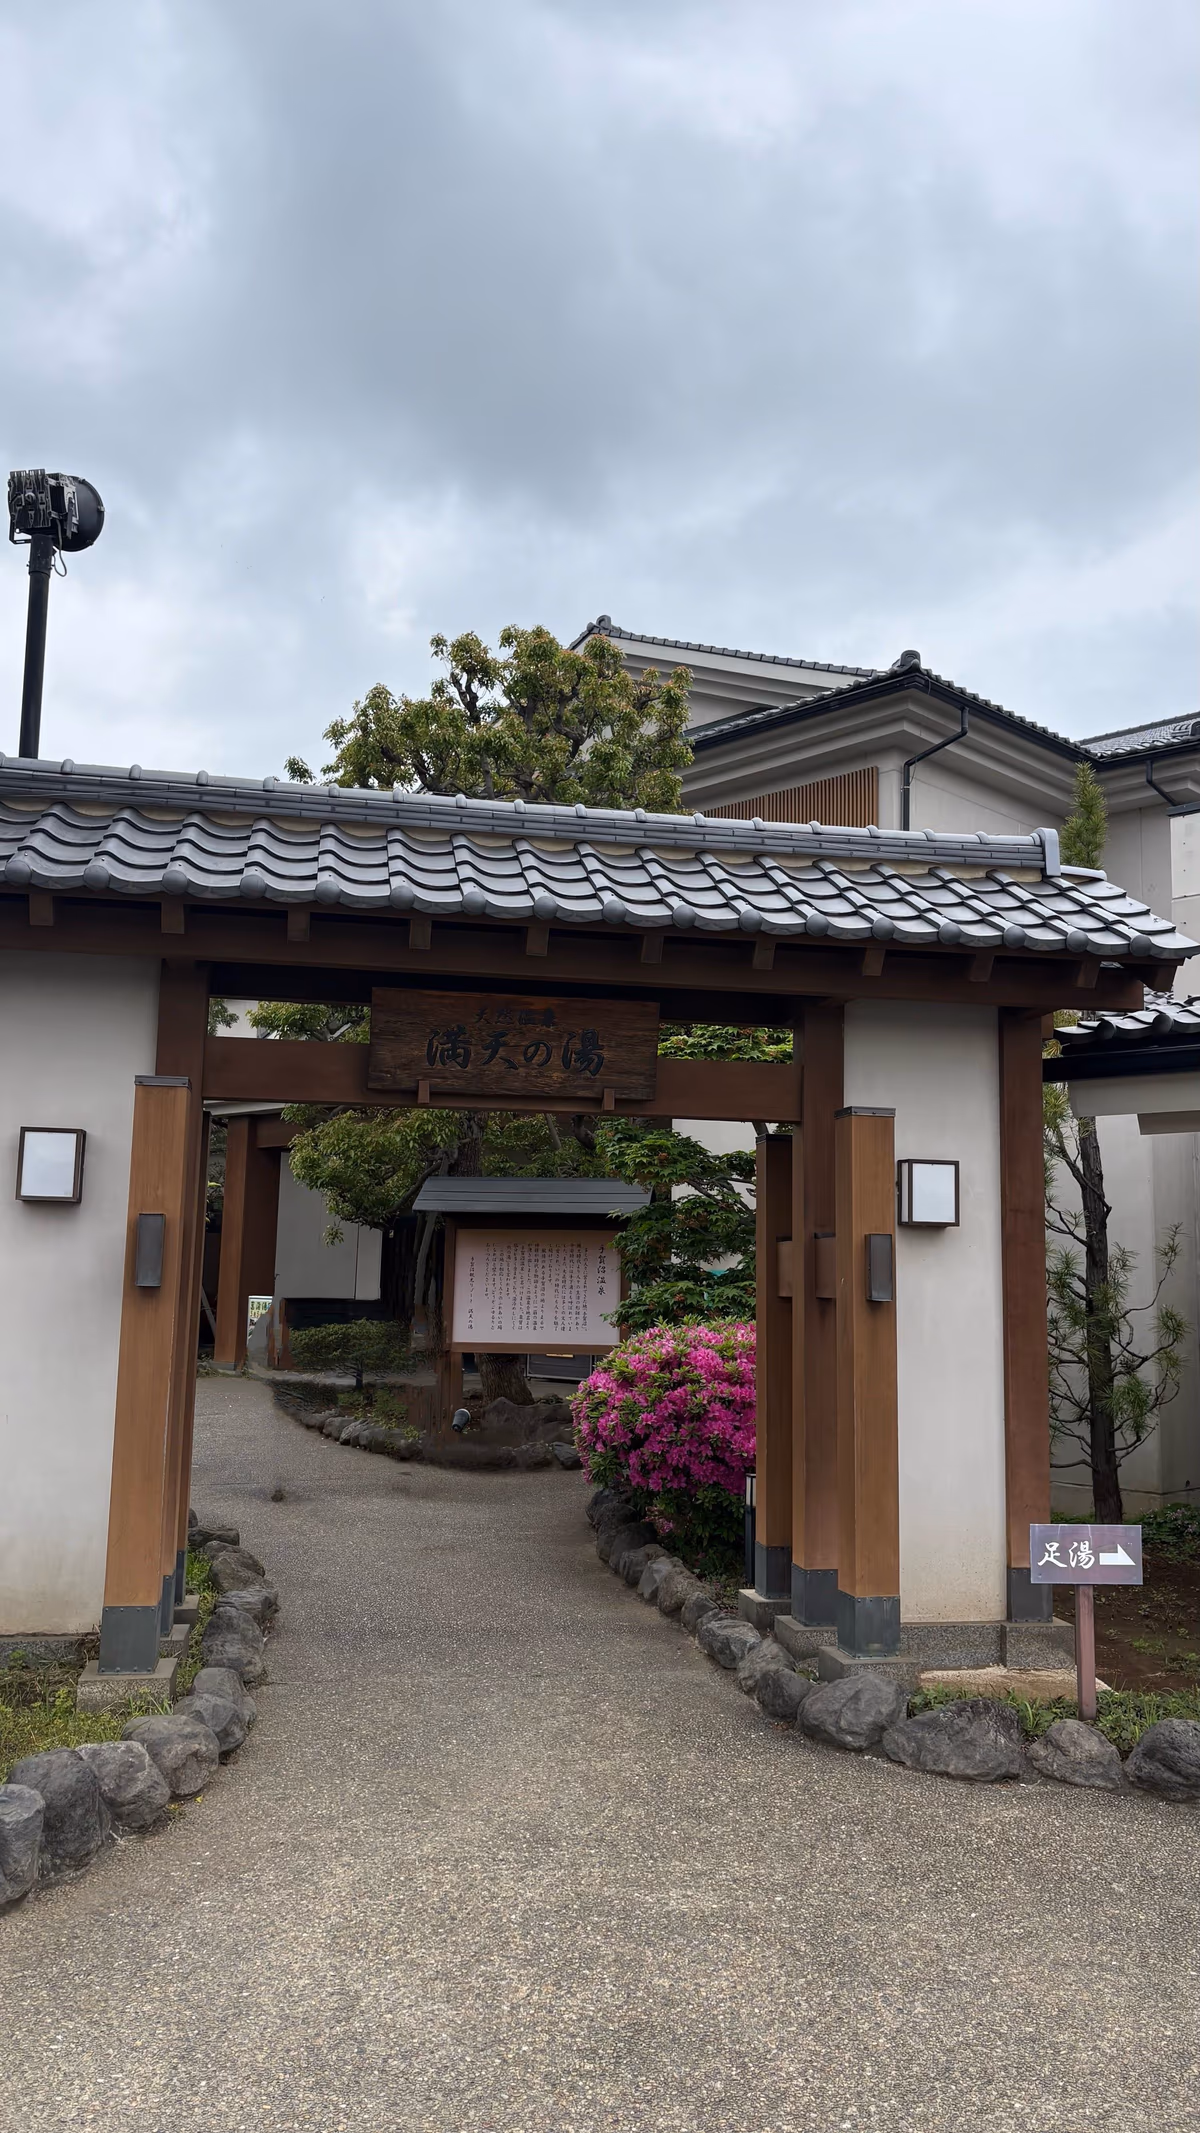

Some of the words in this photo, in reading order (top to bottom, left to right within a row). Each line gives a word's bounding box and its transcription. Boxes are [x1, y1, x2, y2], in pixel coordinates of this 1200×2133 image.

[426, 1024, 604, 1077] 満天の湯
[597, 1244, 607, 1296] 手賀沼温泉
[1037, 1541, 1095, 1570] 足湯
